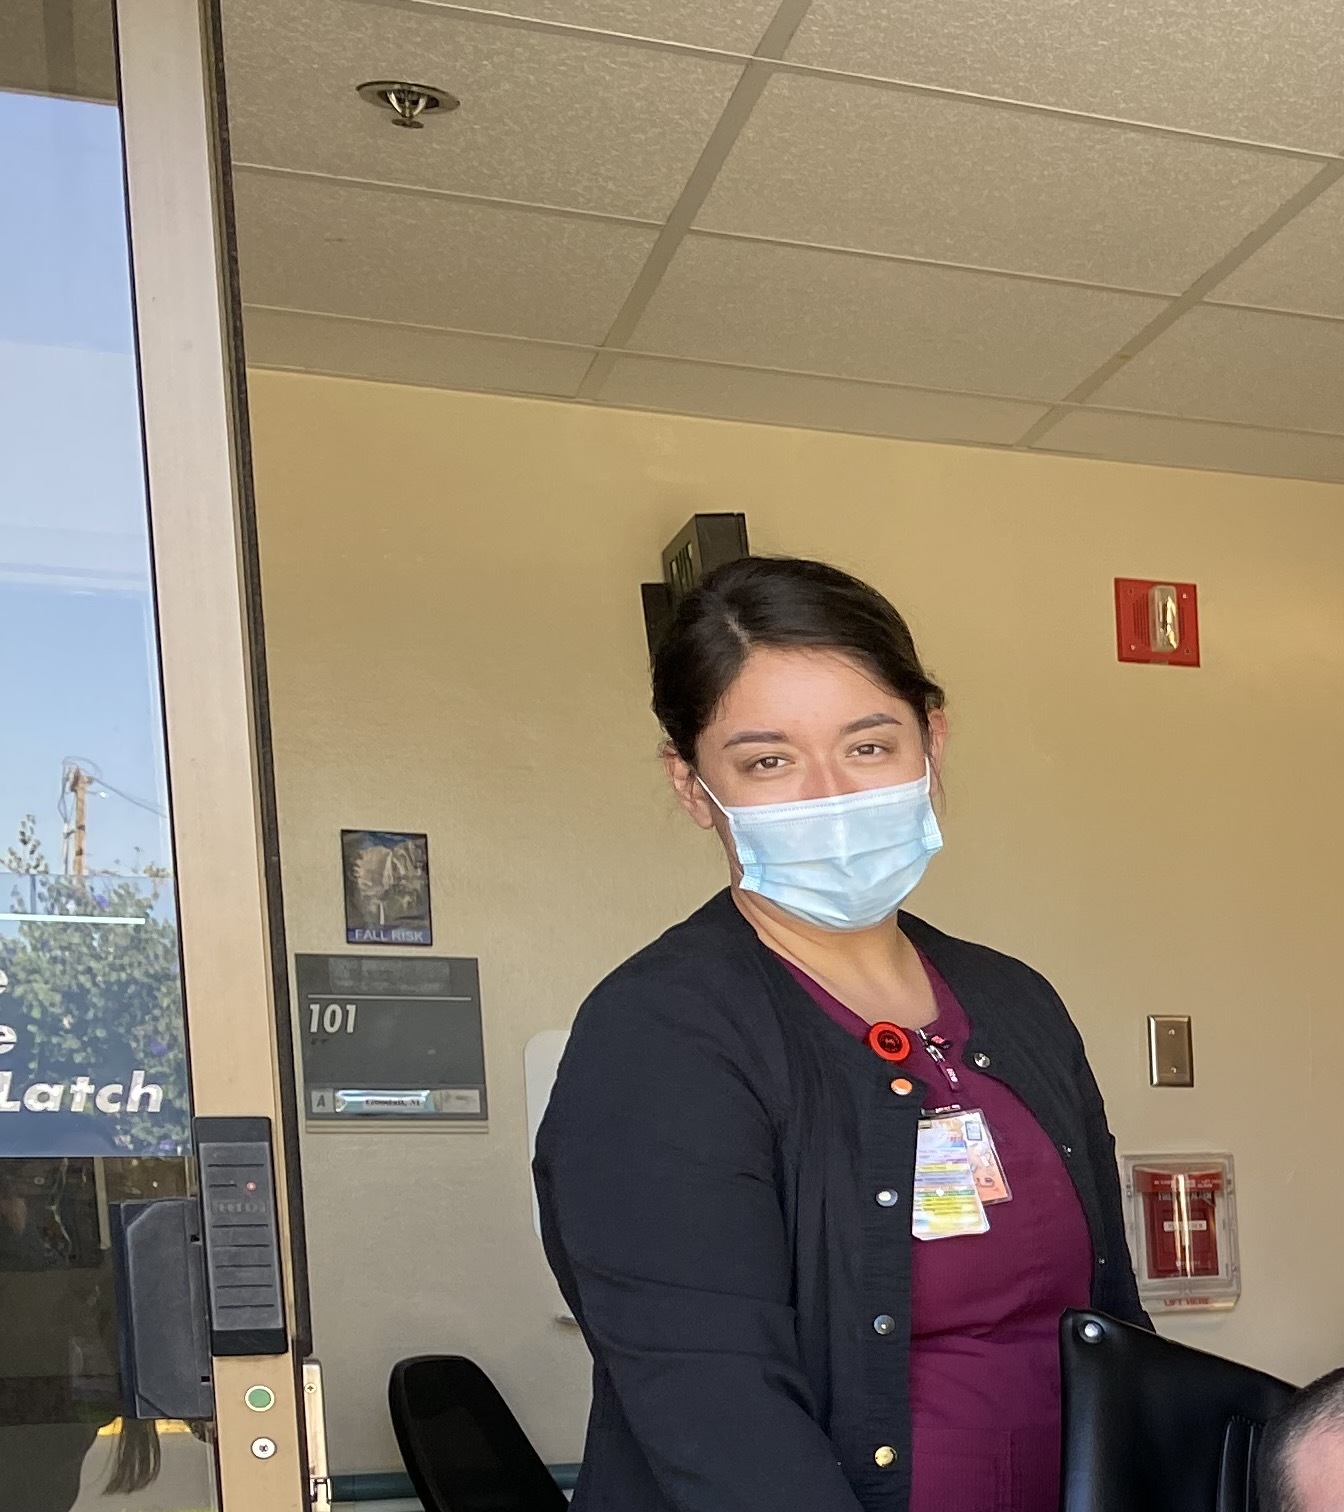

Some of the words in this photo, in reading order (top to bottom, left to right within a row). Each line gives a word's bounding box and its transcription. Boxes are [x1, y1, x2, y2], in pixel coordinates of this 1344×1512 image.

[355, 928, 388, 941] FALL
[391, 929, 424, 942] RISK
[308, 1003, 358, 1034] 101
